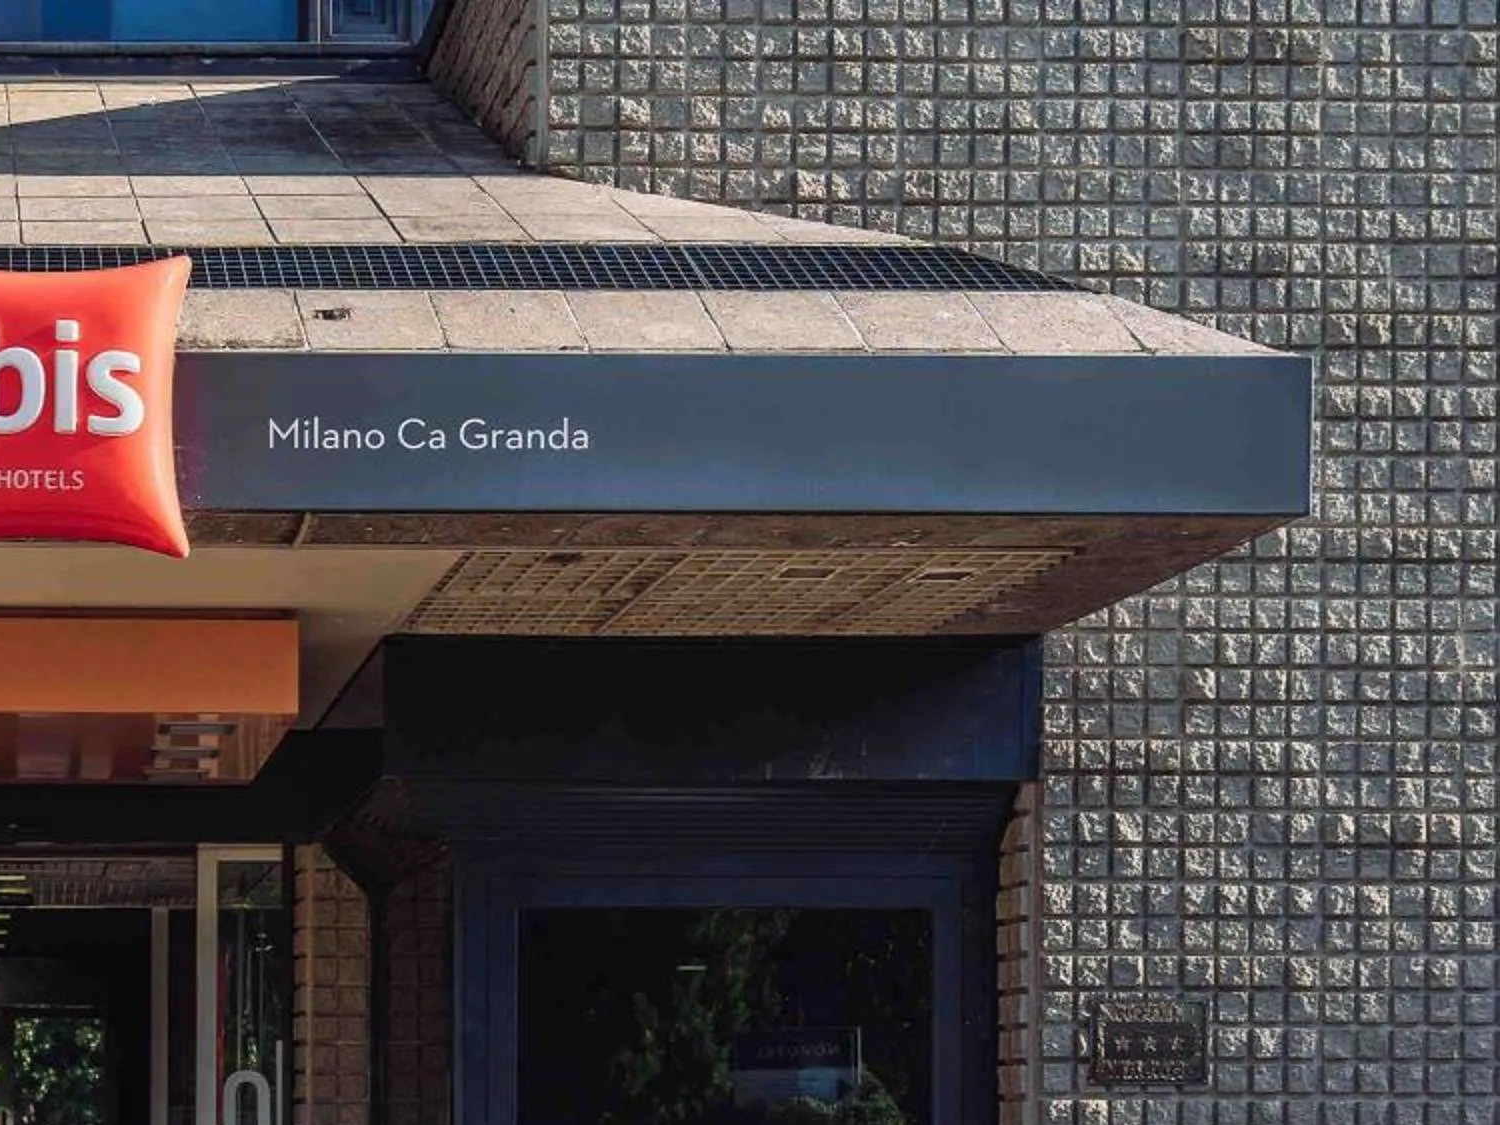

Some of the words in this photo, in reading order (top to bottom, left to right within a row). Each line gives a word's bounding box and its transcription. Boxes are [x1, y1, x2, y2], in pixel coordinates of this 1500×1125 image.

[267, 417, 385, 451] Milano
[397, 418, 447, 451] Ca
[458, 417, 591, 451] Granda
